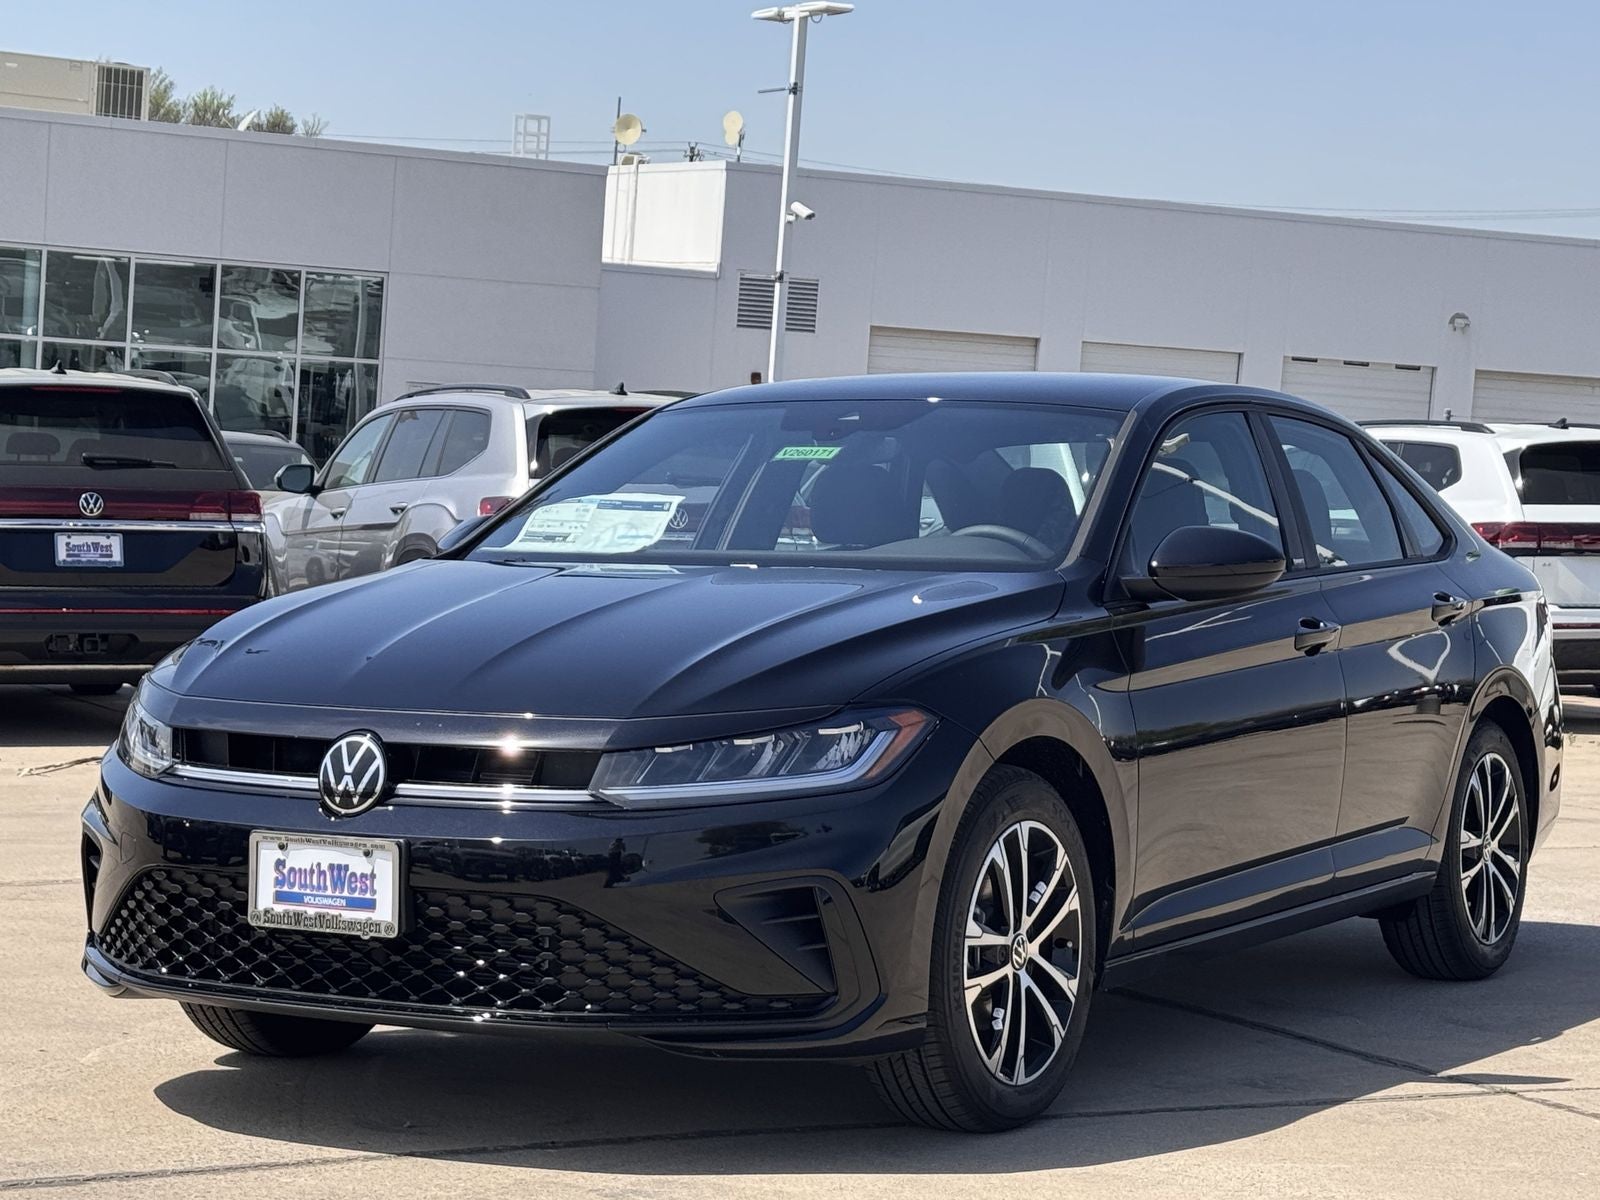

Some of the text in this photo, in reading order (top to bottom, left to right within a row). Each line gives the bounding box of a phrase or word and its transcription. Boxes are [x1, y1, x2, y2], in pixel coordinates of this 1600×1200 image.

[782, 448, 835, 457] V260171
[65, 541, 113, 553] SouthWest
[274, 858, 377, 896] SouthWest
[303, 895, 347, 907] VOLKSWAGEN
[263, 908, 382, 936] SouthWestVolkswagen
